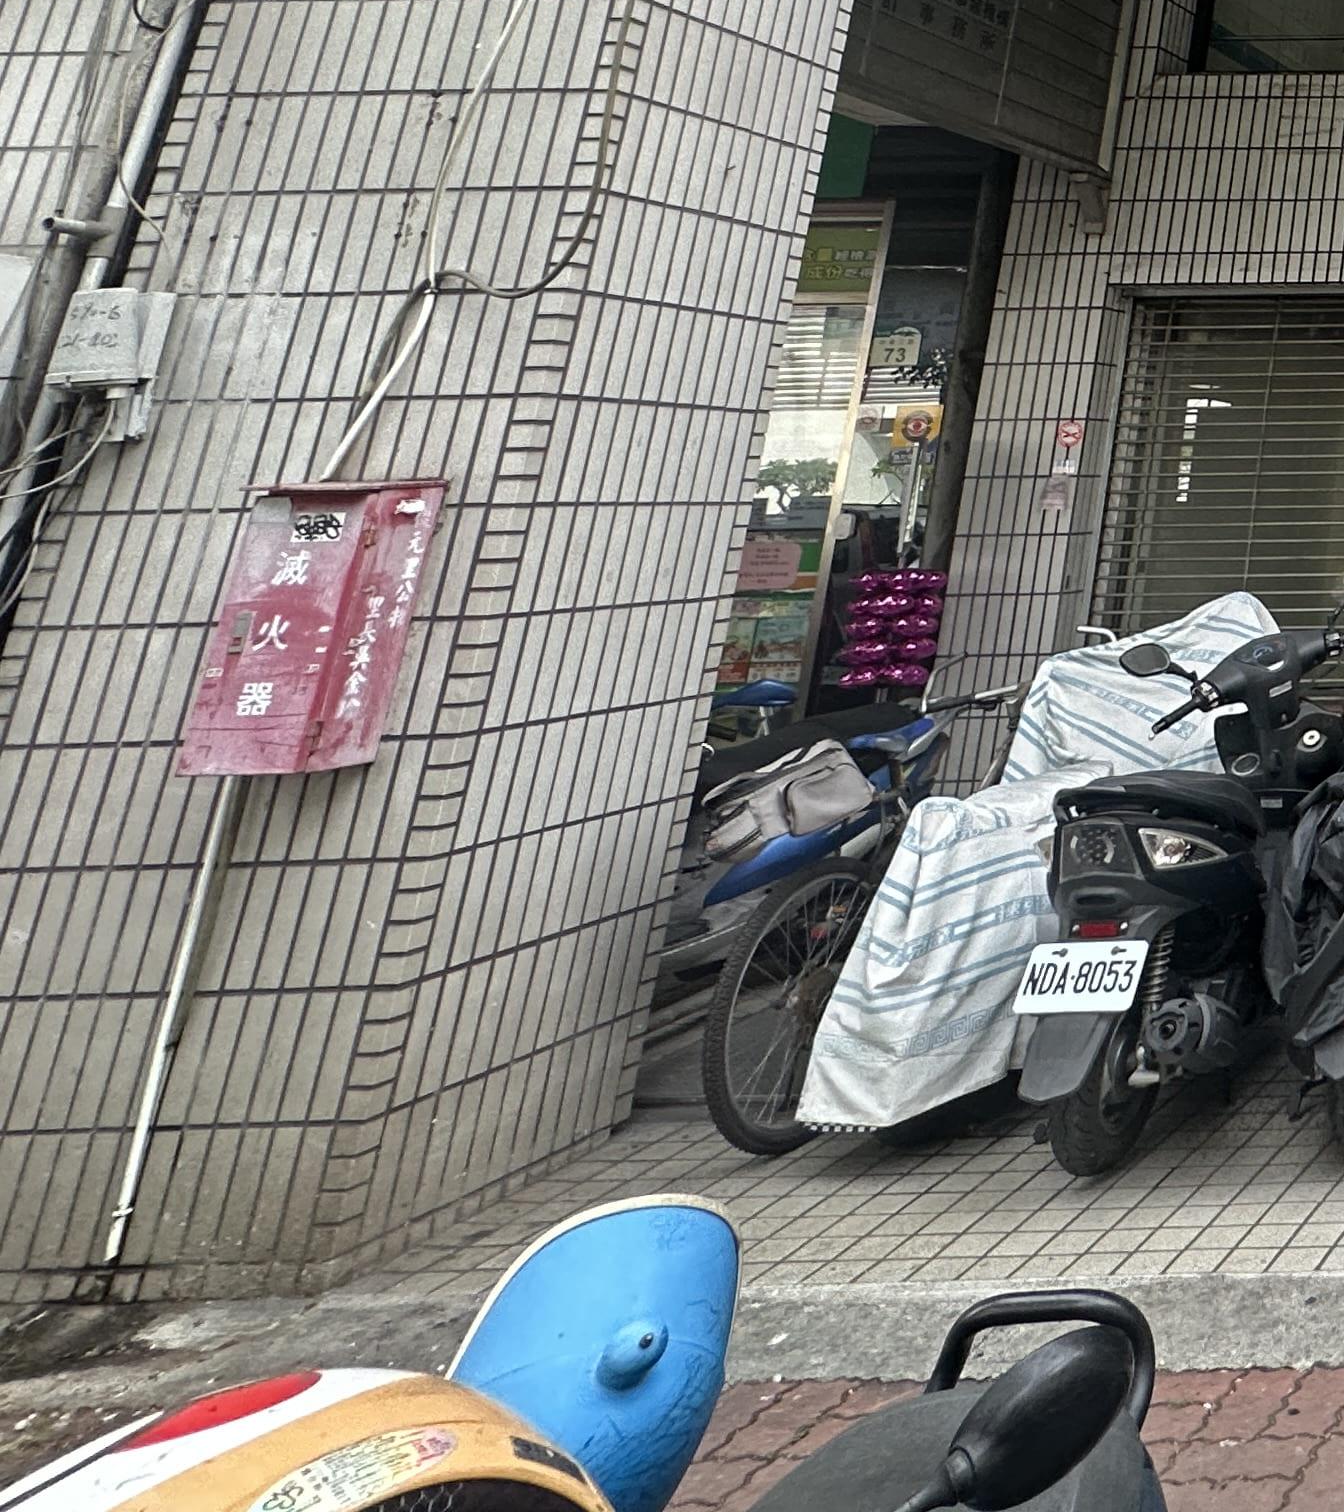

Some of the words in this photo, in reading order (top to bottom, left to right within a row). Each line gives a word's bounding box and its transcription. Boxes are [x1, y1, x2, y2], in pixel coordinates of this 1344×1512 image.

[884, 347, 907, 363] 73
[236, 550, 312, 715] 滅火器
[1023, 960, 1138, 996] NDA-8053
